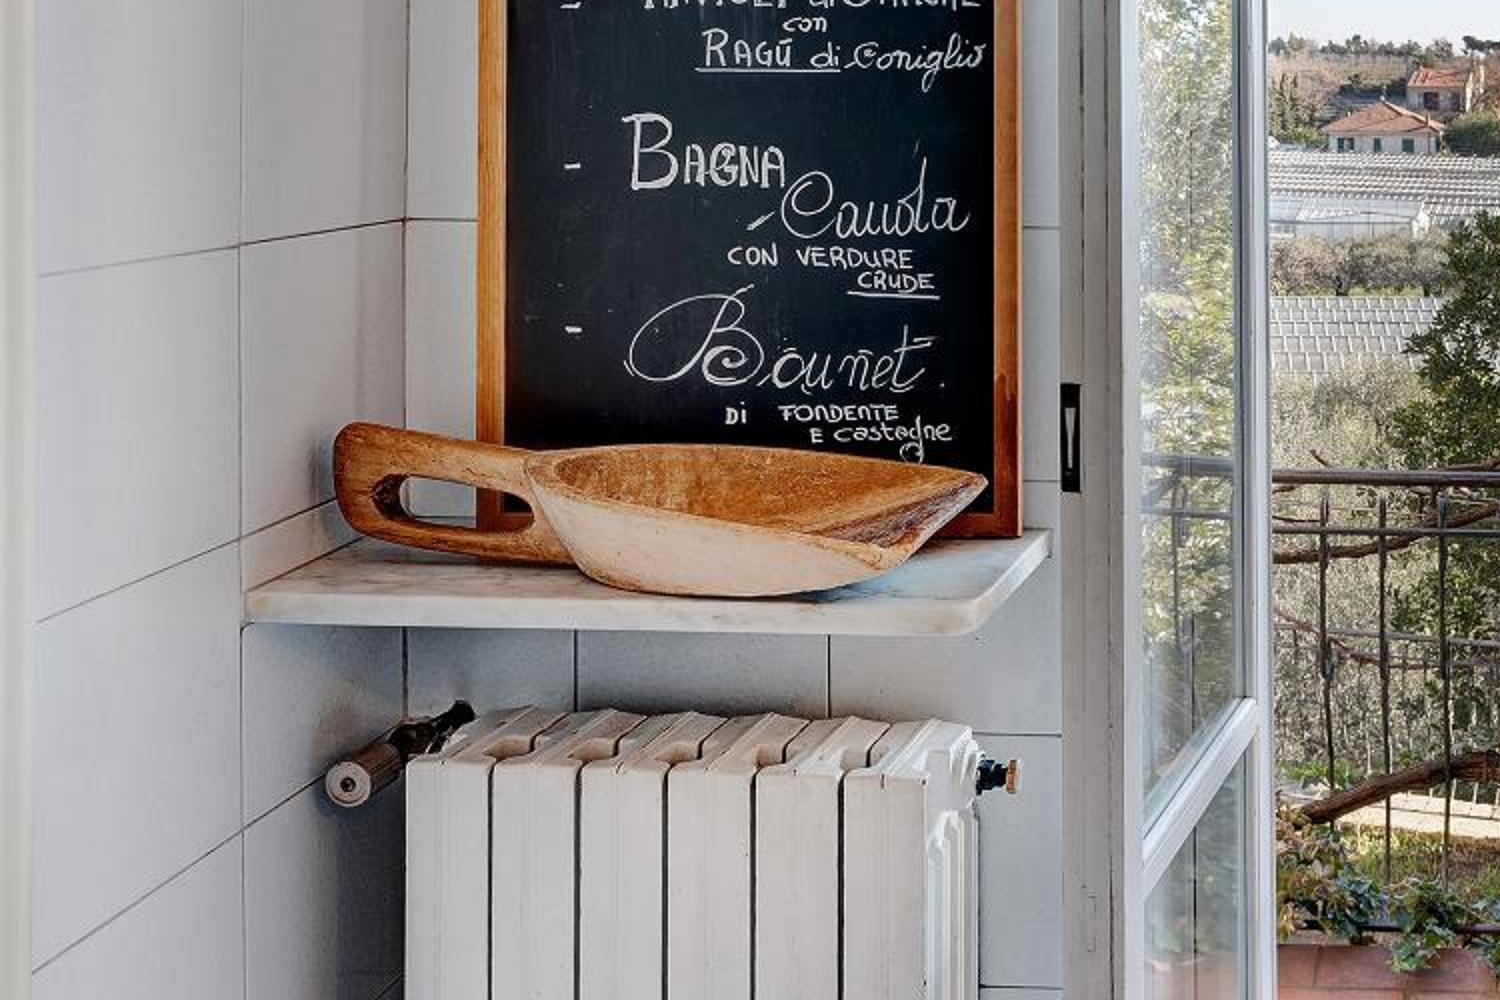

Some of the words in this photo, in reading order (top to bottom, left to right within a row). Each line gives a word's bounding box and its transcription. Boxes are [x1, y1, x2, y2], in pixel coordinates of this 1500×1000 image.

[809, 41, 841, 68] di
[726, 242, 779, 267] CON
[795, 246, 915, 271] VERDURE
[856, 270, 936, 294] CRUDE
